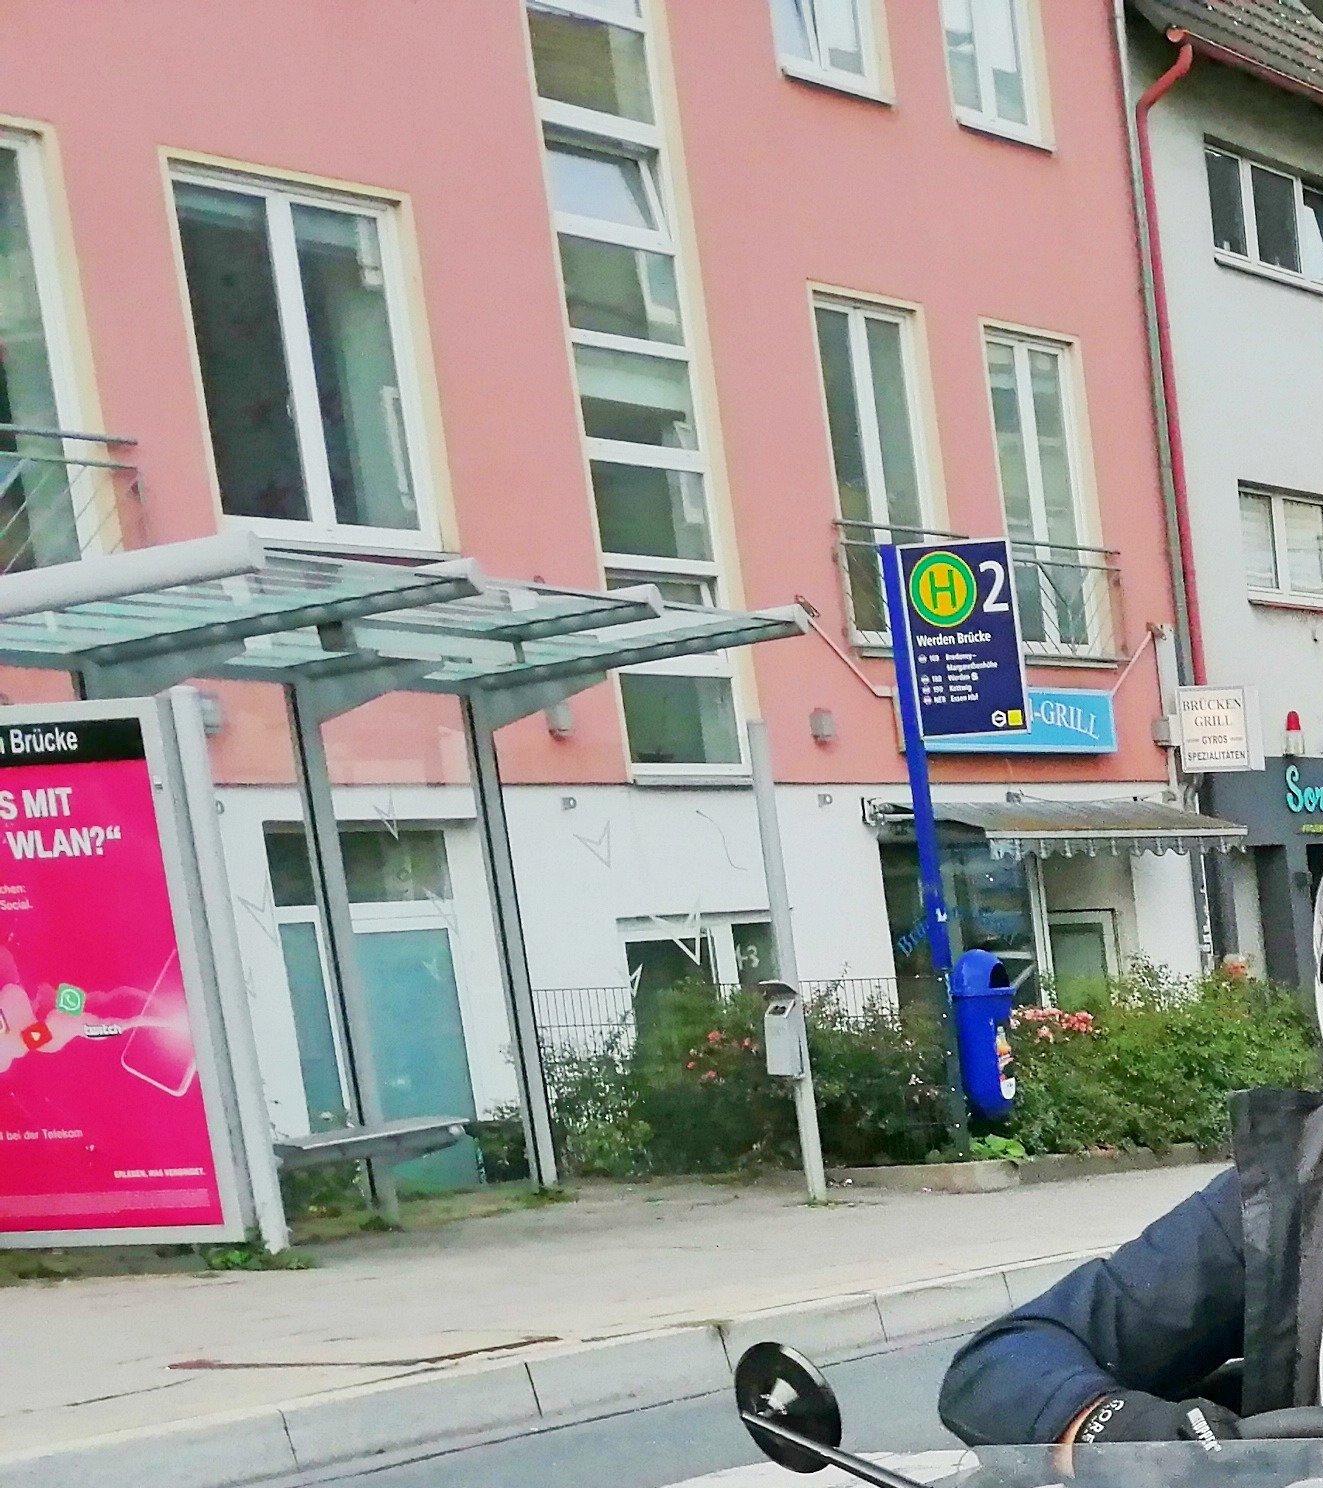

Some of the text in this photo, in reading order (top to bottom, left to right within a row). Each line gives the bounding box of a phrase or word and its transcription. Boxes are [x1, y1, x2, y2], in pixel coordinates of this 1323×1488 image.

[978, 560, 1010, 613] 2
[916, 630, 992, 647] Werden Brücke
[1182, 696, 1242, 712] BRÜCKEN
[1194, 715, 1233, 728] GRILL
[10, 728, 79, 754] Brücke
[1201, 734, 1228, 745] GYROS
[21, 786, 73, 819] MIT
[42, 1128, 84, 1140] Telekom
